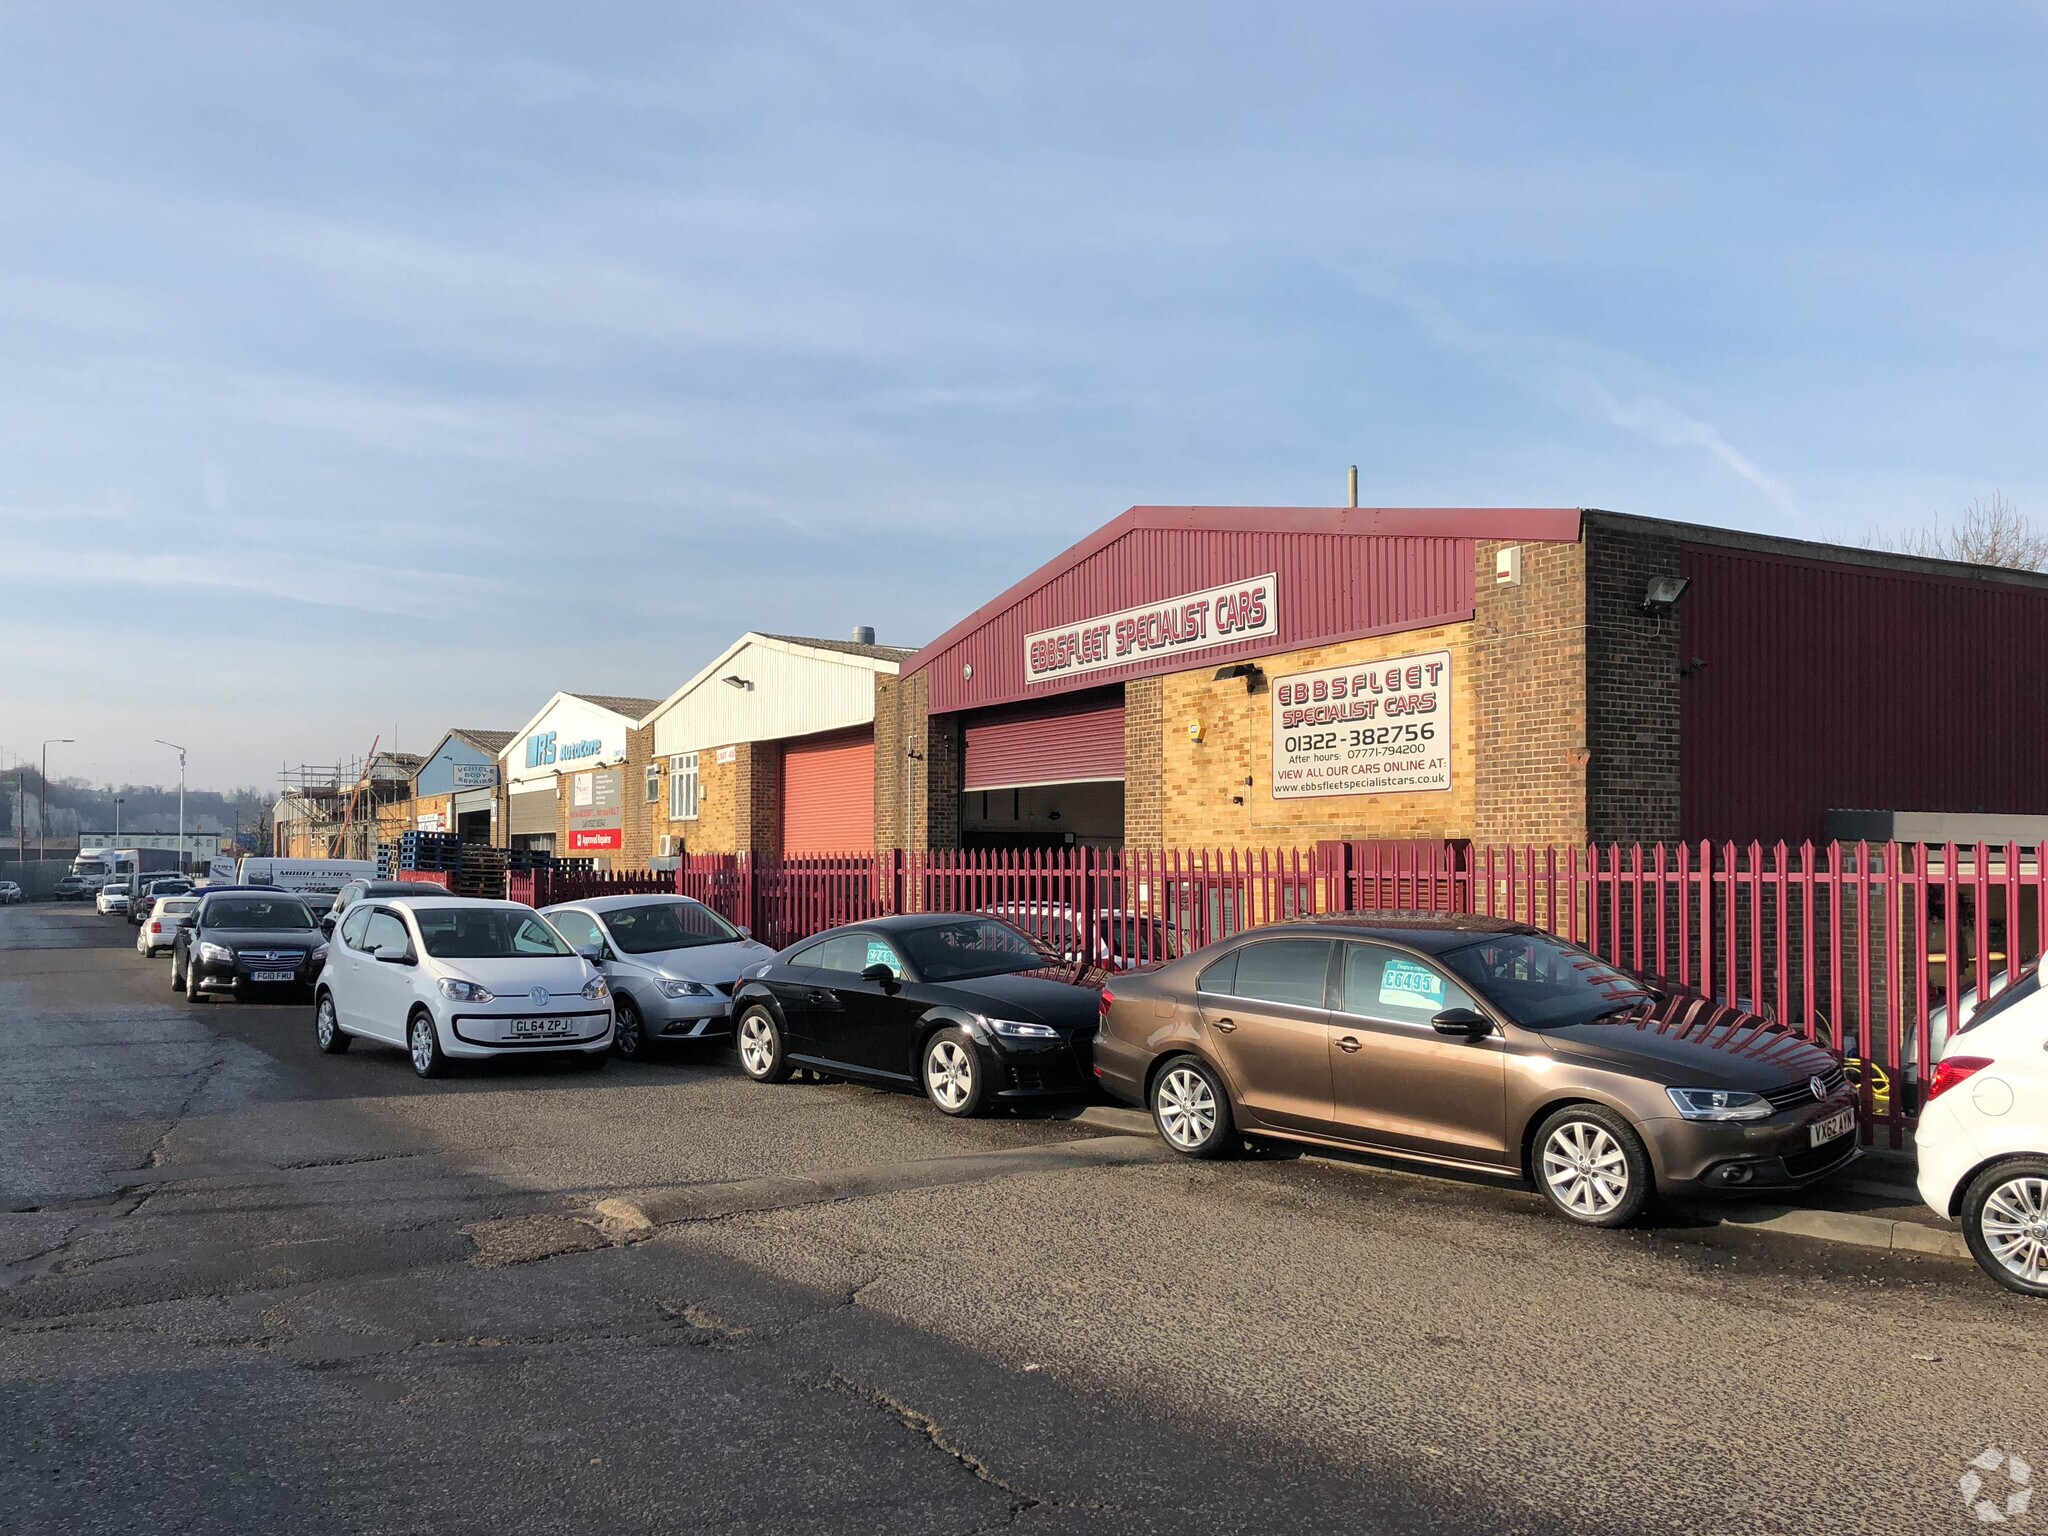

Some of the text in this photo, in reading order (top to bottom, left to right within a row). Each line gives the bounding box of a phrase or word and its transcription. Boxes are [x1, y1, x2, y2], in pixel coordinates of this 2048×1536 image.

[1030, 586, 1266, 674] EBBSFLEET SPECIALIST CARS
[1278, 660, 1443, 706] EBBSFLEET
[1282, 691, 1437, 729] SPECIALIST CARS
[1289, 743, 1426, 765] After hours: 07771-794200
[457, 766, 495, 775] VEHICLE
[1278, 757, 1447, 780] VIEW ALL OUR CARS ONLINE AT:
[1274, 773, 1445, 793] www.ebbsfleetspecialistcars.co.uk
[1385, 971, 1431, 991] £6495
[516, 1020, 568, 1031] GL64 ZPJ
